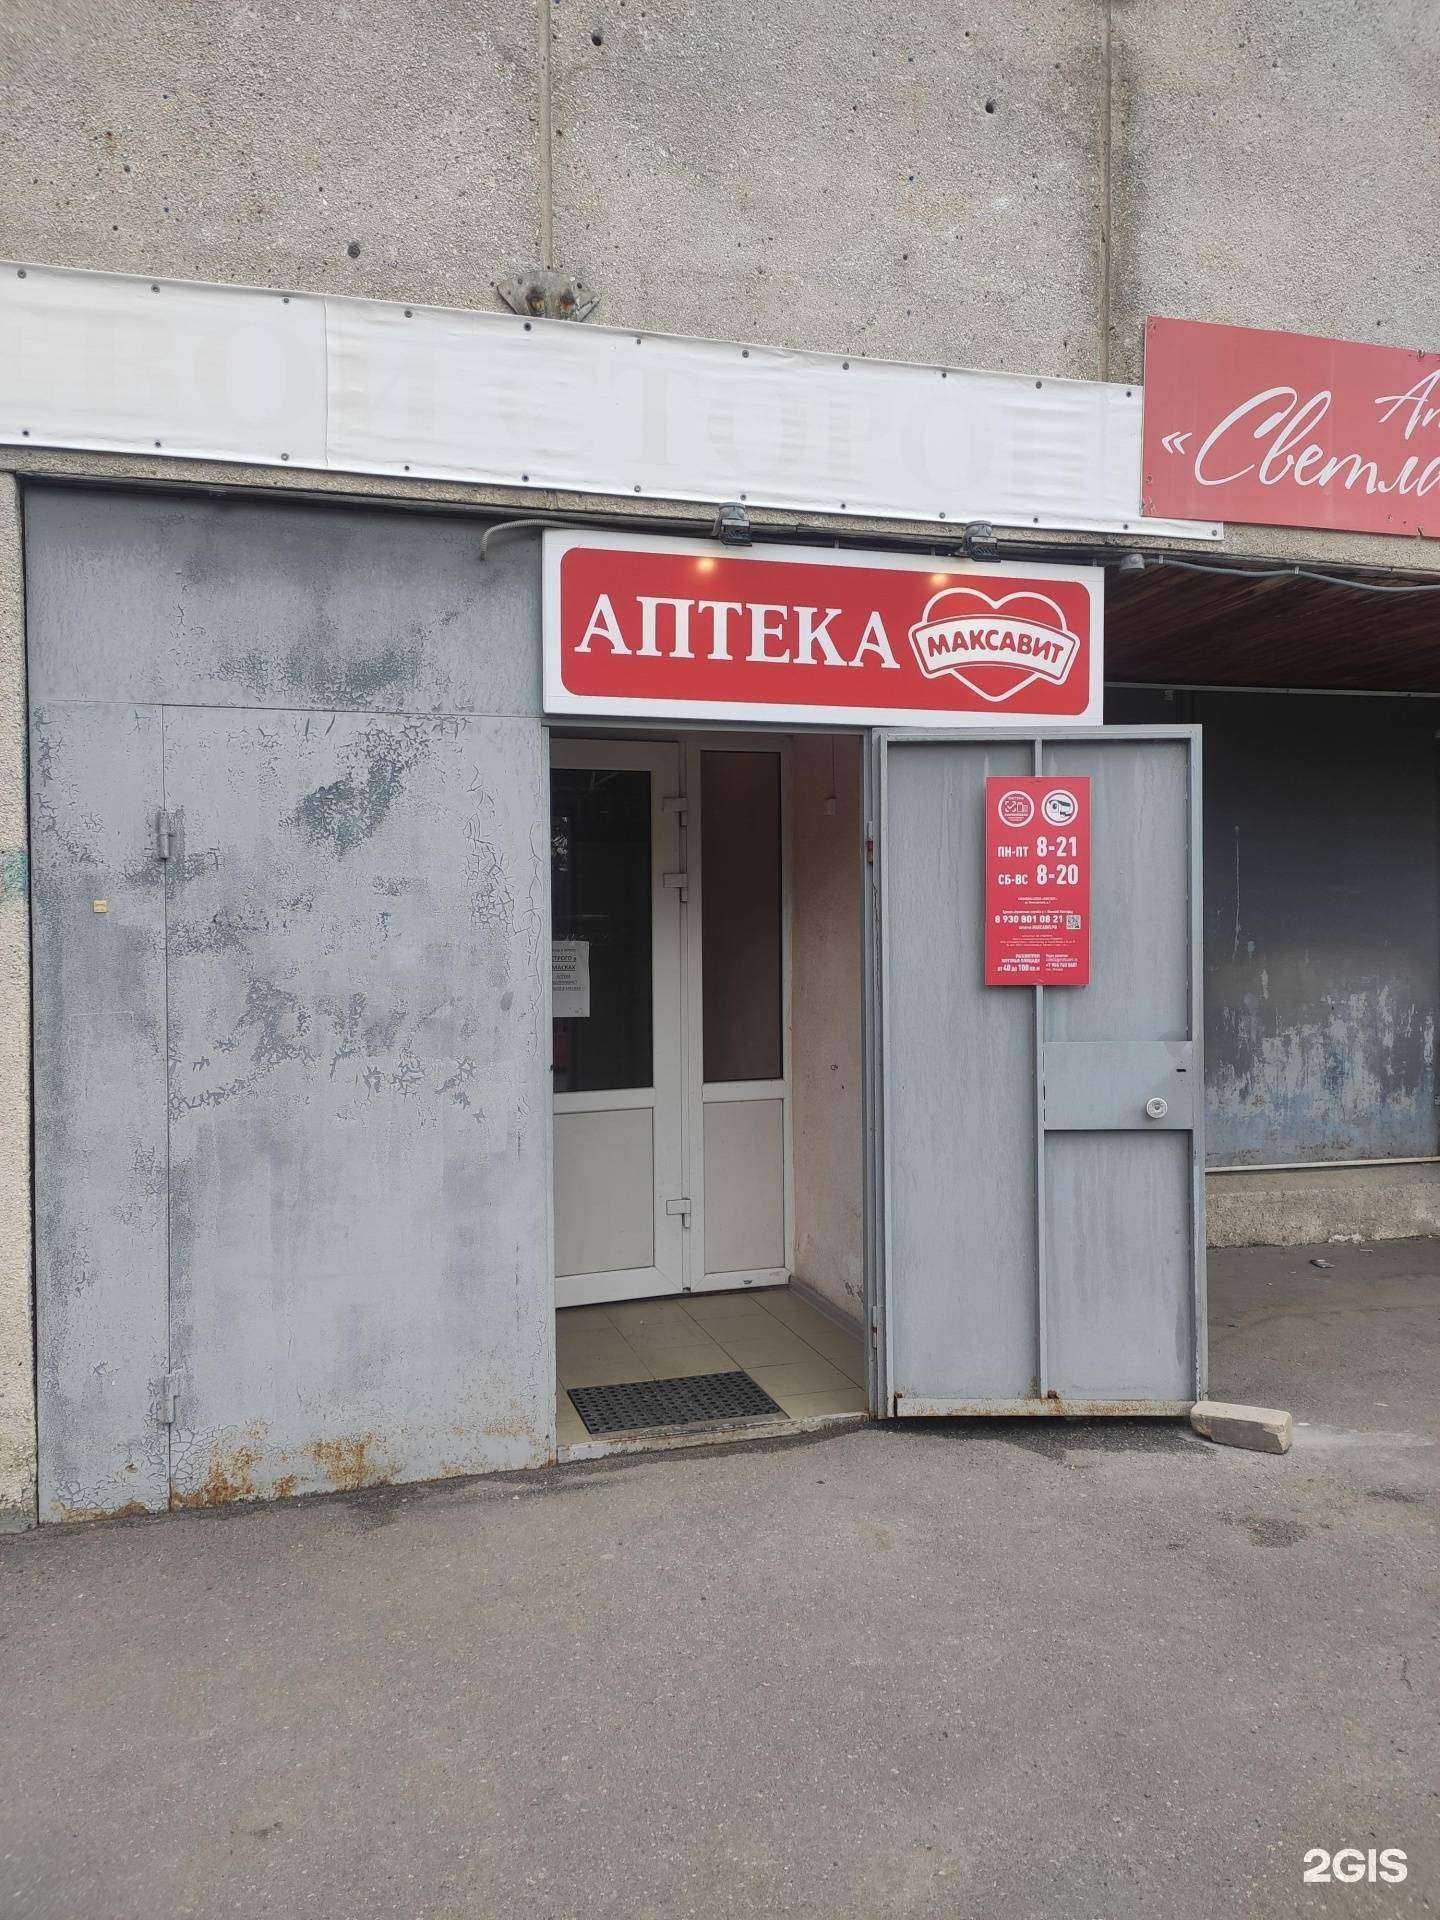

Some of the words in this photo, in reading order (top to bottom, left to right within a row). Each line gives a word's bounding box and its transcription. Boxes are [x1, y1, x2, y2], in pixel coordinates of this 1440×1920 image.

[574, 592, 901, 669] АПТЕКА
[927, 627, 1065, 664] МАКСАВИТ
[997, 846, 1029, 858] ПН-ПТ
[1036, 836, 1077, 857] 8-21
[997, 874, 1029, 885] СБ-ВС
[1036, 864, 1079, 885] 8-20
[994, 915, 1001, 924] 8
